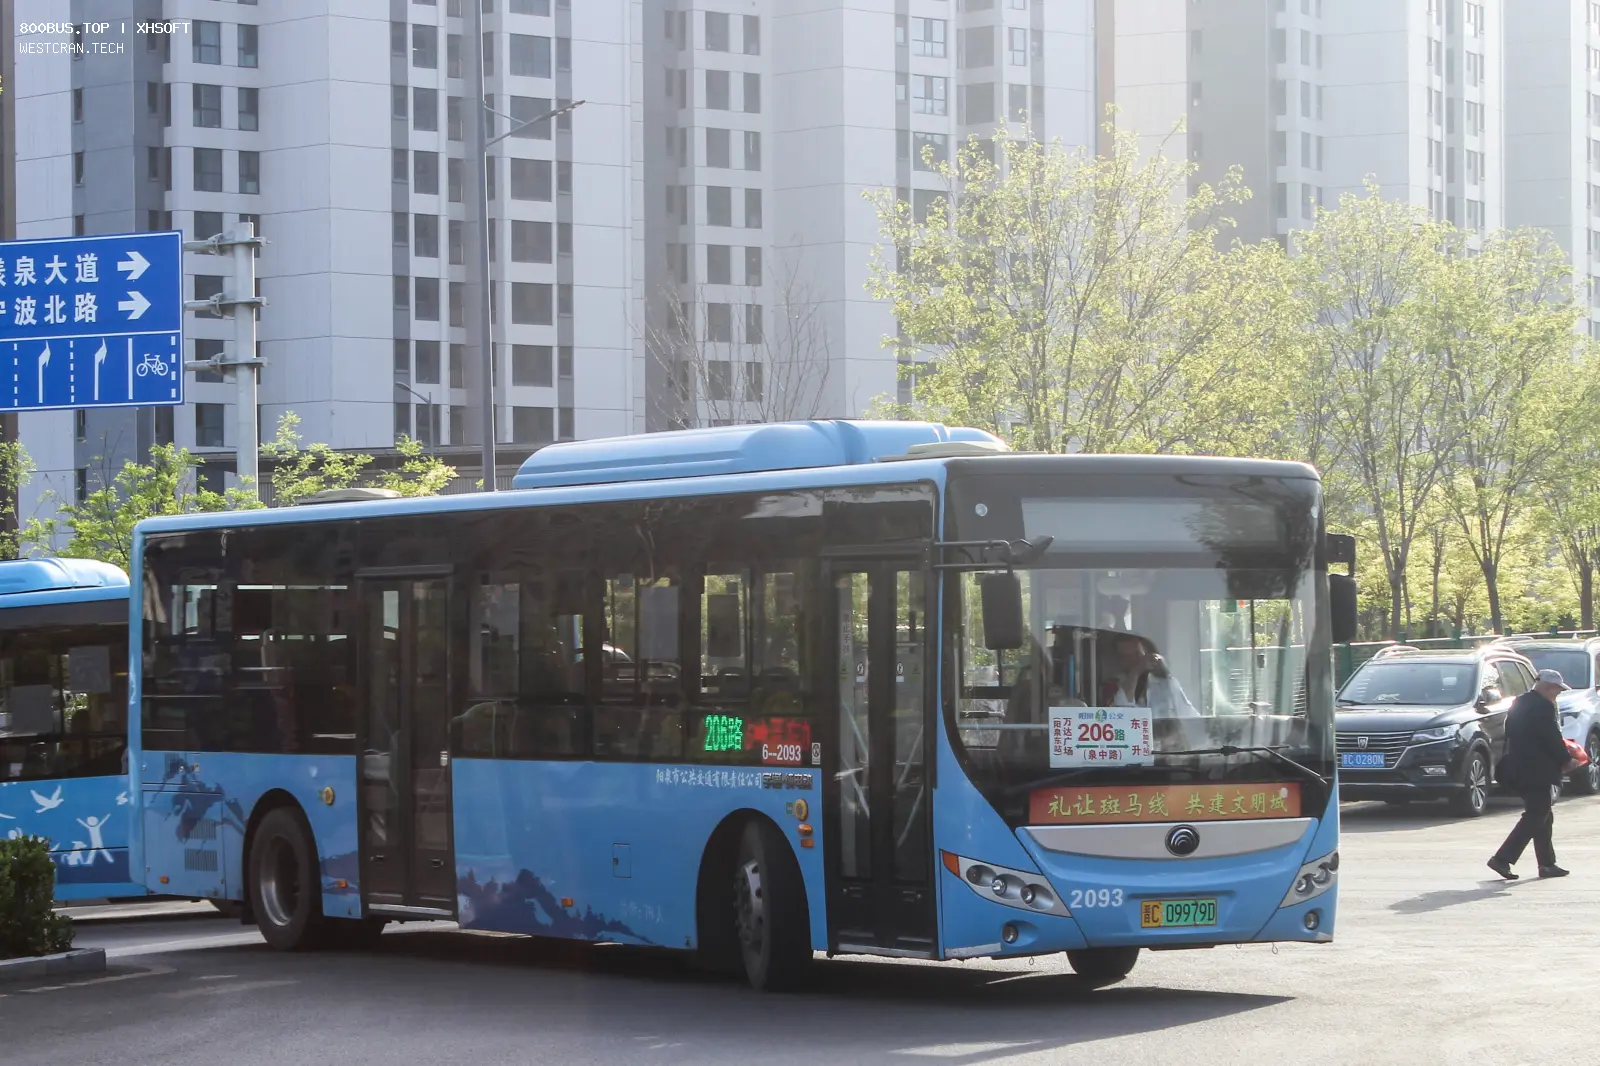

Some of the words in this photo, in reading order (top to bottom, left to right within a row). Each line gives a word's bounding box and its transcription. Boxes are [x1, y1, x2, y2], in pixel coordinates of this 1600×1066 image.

[0, 292, 98, 325] 波北路
[704, 714, 743, 751] 206路
[1062, 717, 1074, 756] 万达广场
[1077, 722, 1125, 742] 206路
[1130, 717, 1142, 756] 东升
[1048, 792, 1169, 818] 礼让斑马线
[1184, 789, 1288, 815] 共建文明城
[1070, 888, 1123, 909] 2093
